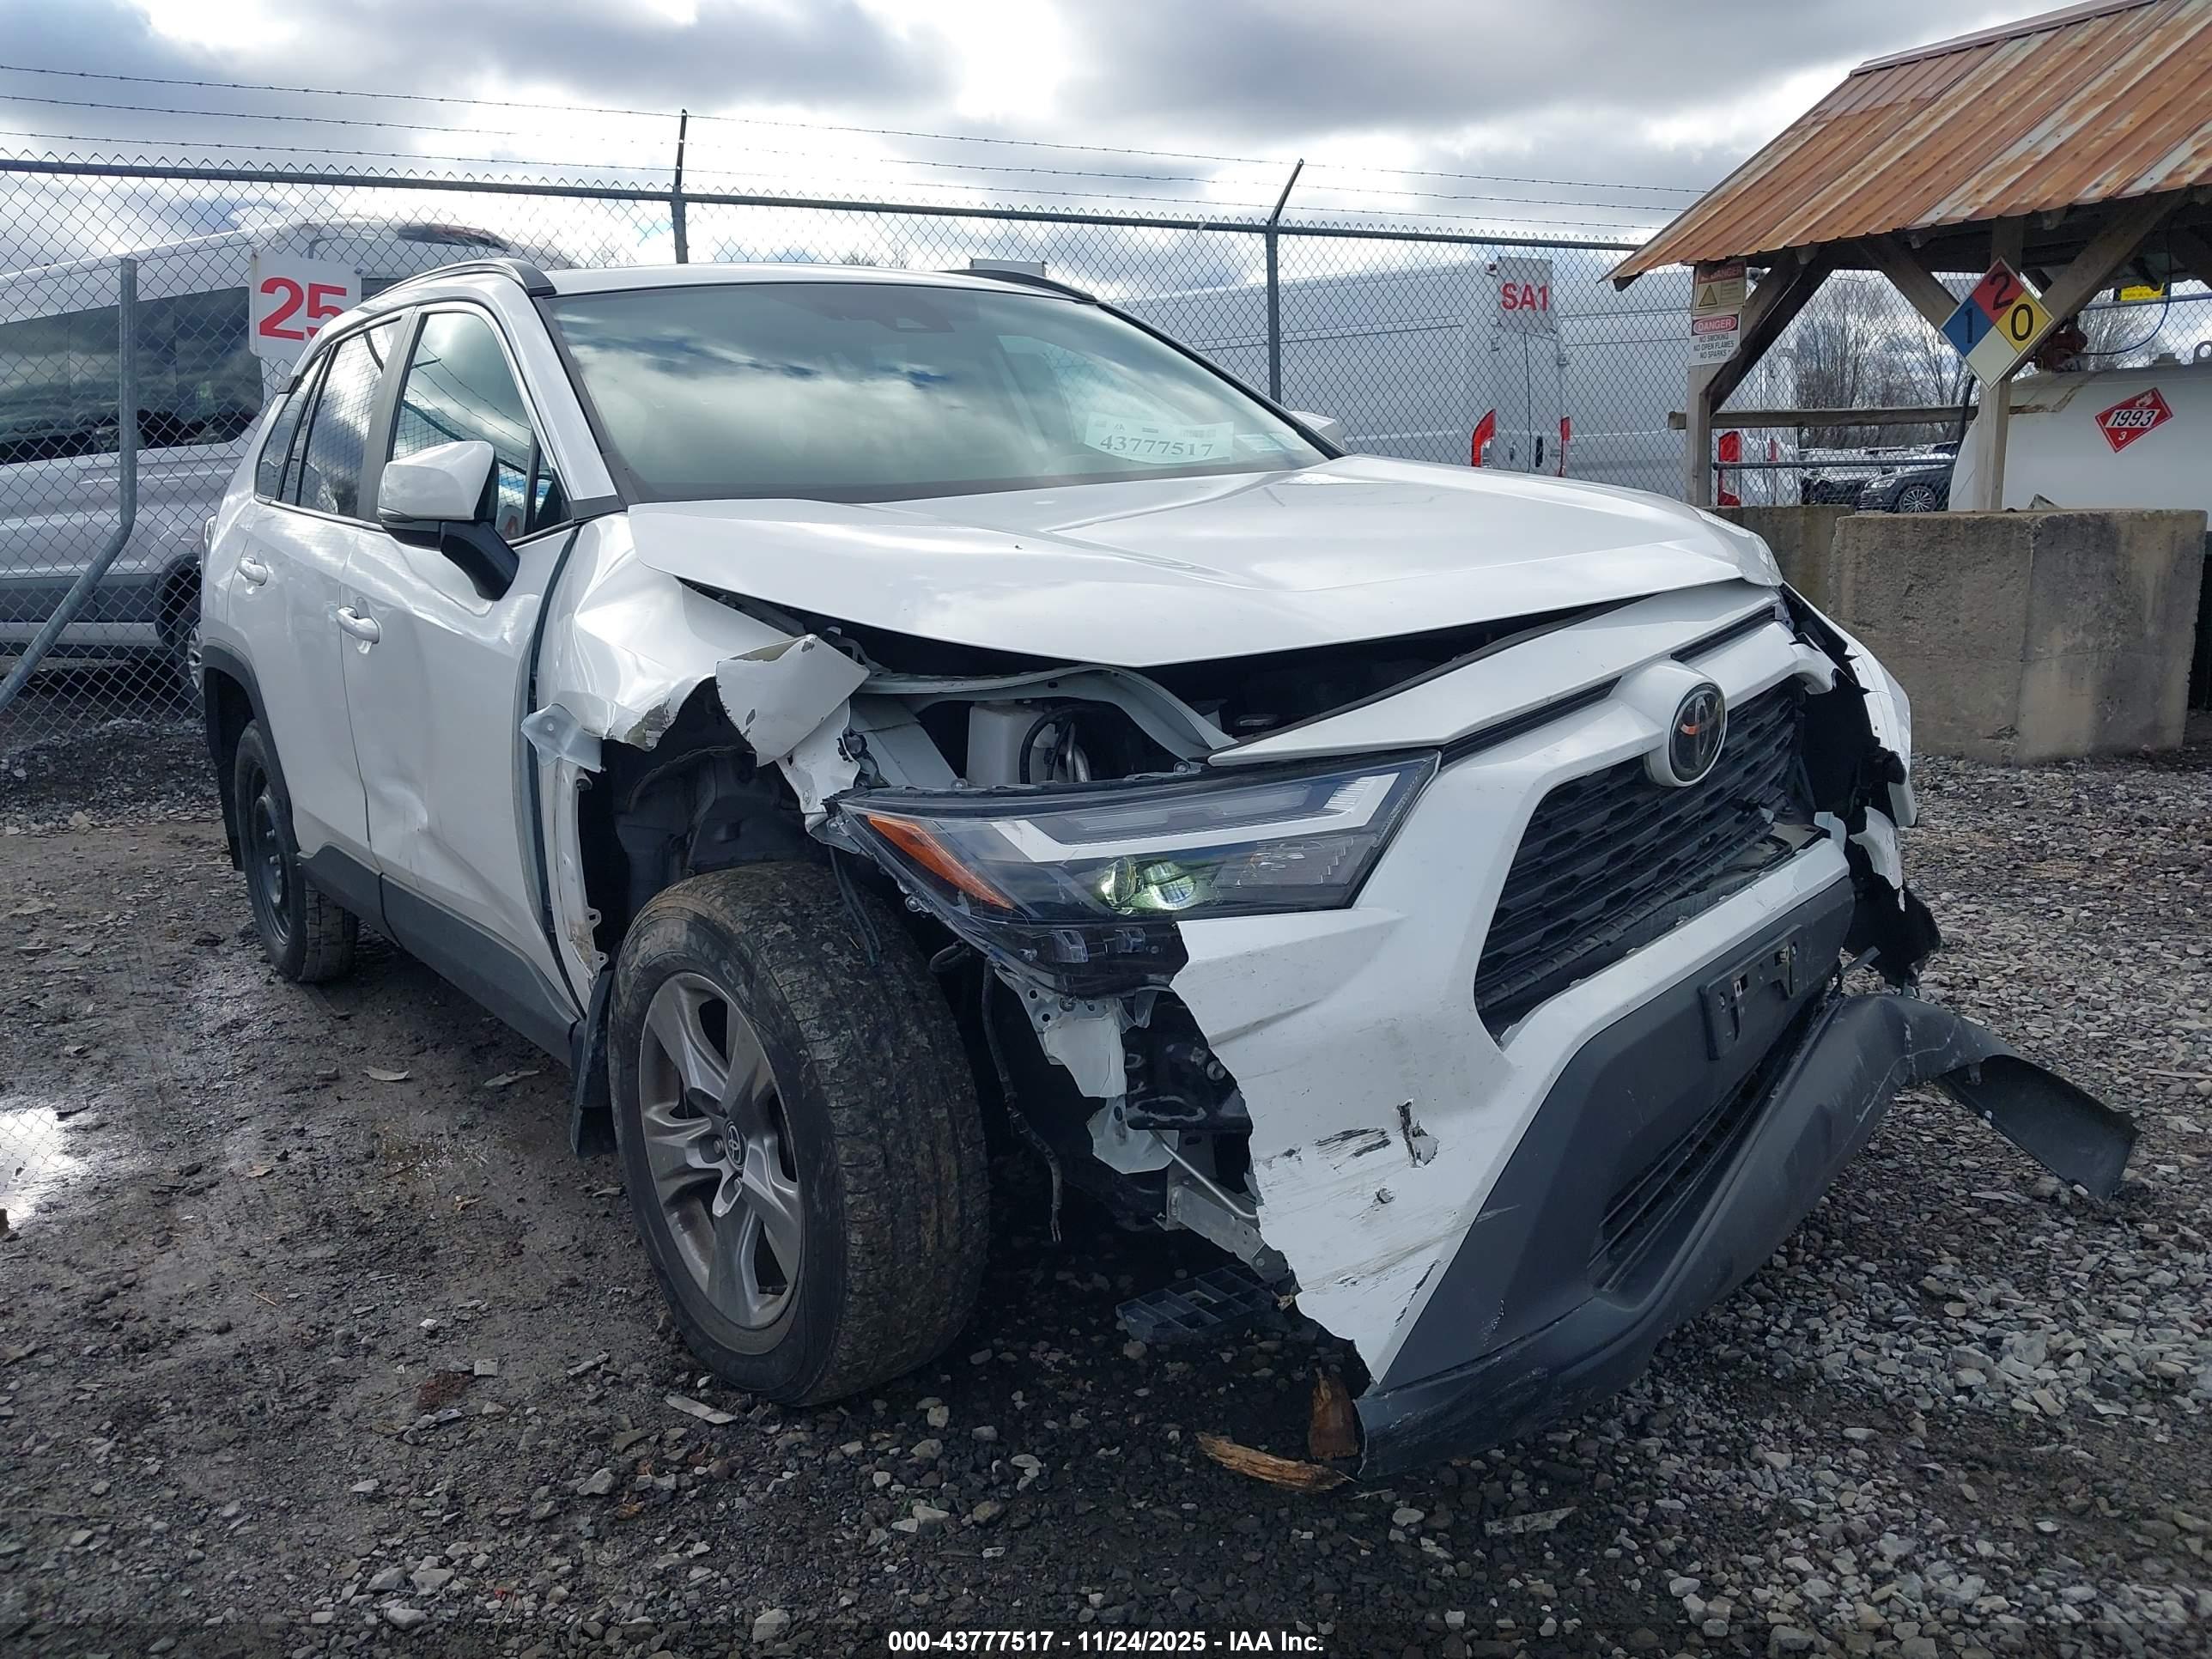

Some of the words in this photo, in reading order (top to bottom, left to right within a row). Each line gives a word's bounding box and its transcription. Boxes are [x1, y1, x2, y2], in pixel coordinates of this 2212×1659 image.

[1501, 282, 1547, 312] SA1
[1989, 271, 2014, 311] 2
[258, 276, 347, 341] 25
[1698, 319, 1732, 331] DANGER
[1964, 307, 1974, 344] 1
[2010, 303, 2034, 342] 0
[1701, 343, 1714, 351] OPEN
[1715, 340, 1734, 349] FLAMES
[1707, 333, 1729, 342] SMOKING
[2111, 410, 2155, 427] 1993
[1100, 434, 1213, 457] 43777517
[2118, 431, 2128, 441] 3
